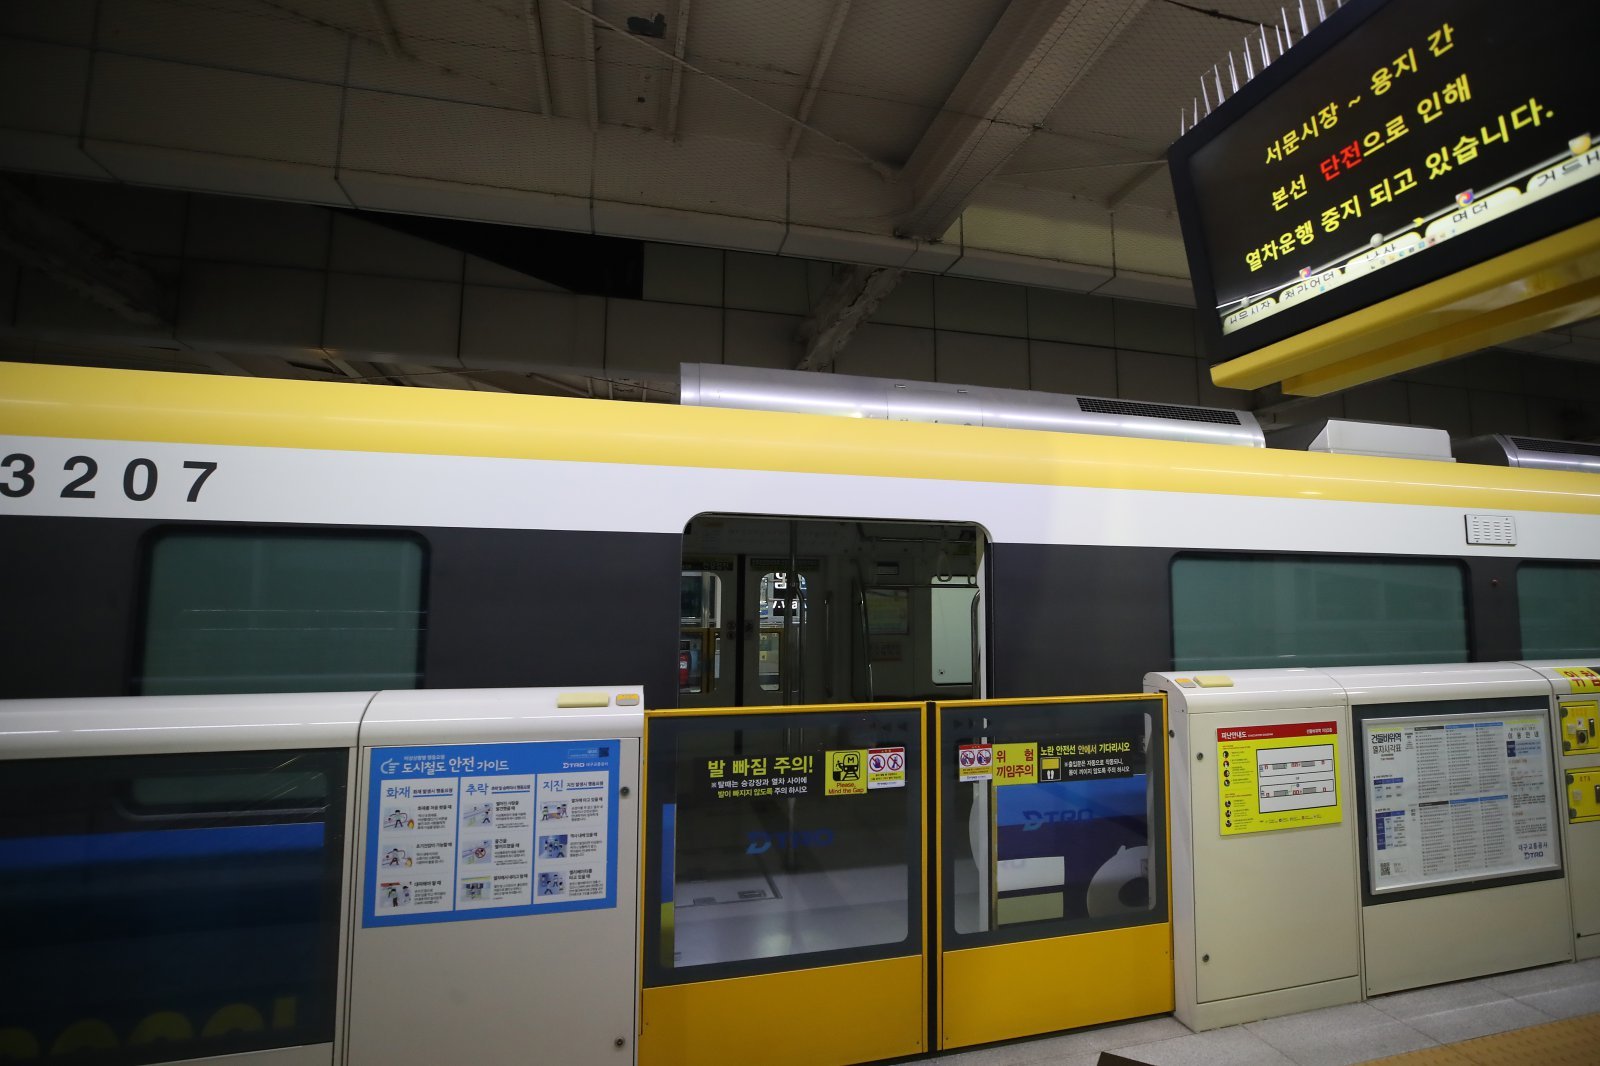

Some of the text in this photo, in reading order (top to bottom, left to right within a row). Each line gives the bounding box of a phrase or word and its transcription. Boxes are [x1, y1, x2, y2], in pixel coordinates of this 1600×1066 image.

[1266, 102, 1339, 164] 서문시장
[1370, 48, 1418, 95] 용지
[1427, 23, 1454, 57] 간
[1271, 73, 1471, 211] 본선 단전으로 인해
[1245, 98, 1554, 272] 열차운행 중지 되고 있습니다.
[0, 452, 218, 503] 3207
[1371, 732, 1402, 744] 건들바위역
[1040, 742, 1131, 756] 노란 안전선 안에서 기다리시오
[1372, 743, 1402, 754] 열차시각표
[402, 756, 510, 776] 도시철도 안전 가이드
[708, 755, 813, 778] 발 빠짐 주의!
[996, 764, 1034, 778] 끼임주의
[543, 779, 564, 792] 지진
[741, 778, 769, 787] 승강장과
[771, 778, 785, 786] 열차
[787, 776, 807, 784] 사이에
[386, 786, 411, 799] 화재
[466, 783, 489, 796] 추락
[717, 786, 808, 798] 발이 빠지지 않도록 주의 하시오
[1518, 842, 1548, 851] 대구교통공사
[1523, 851, 1544, 859] DTRO
